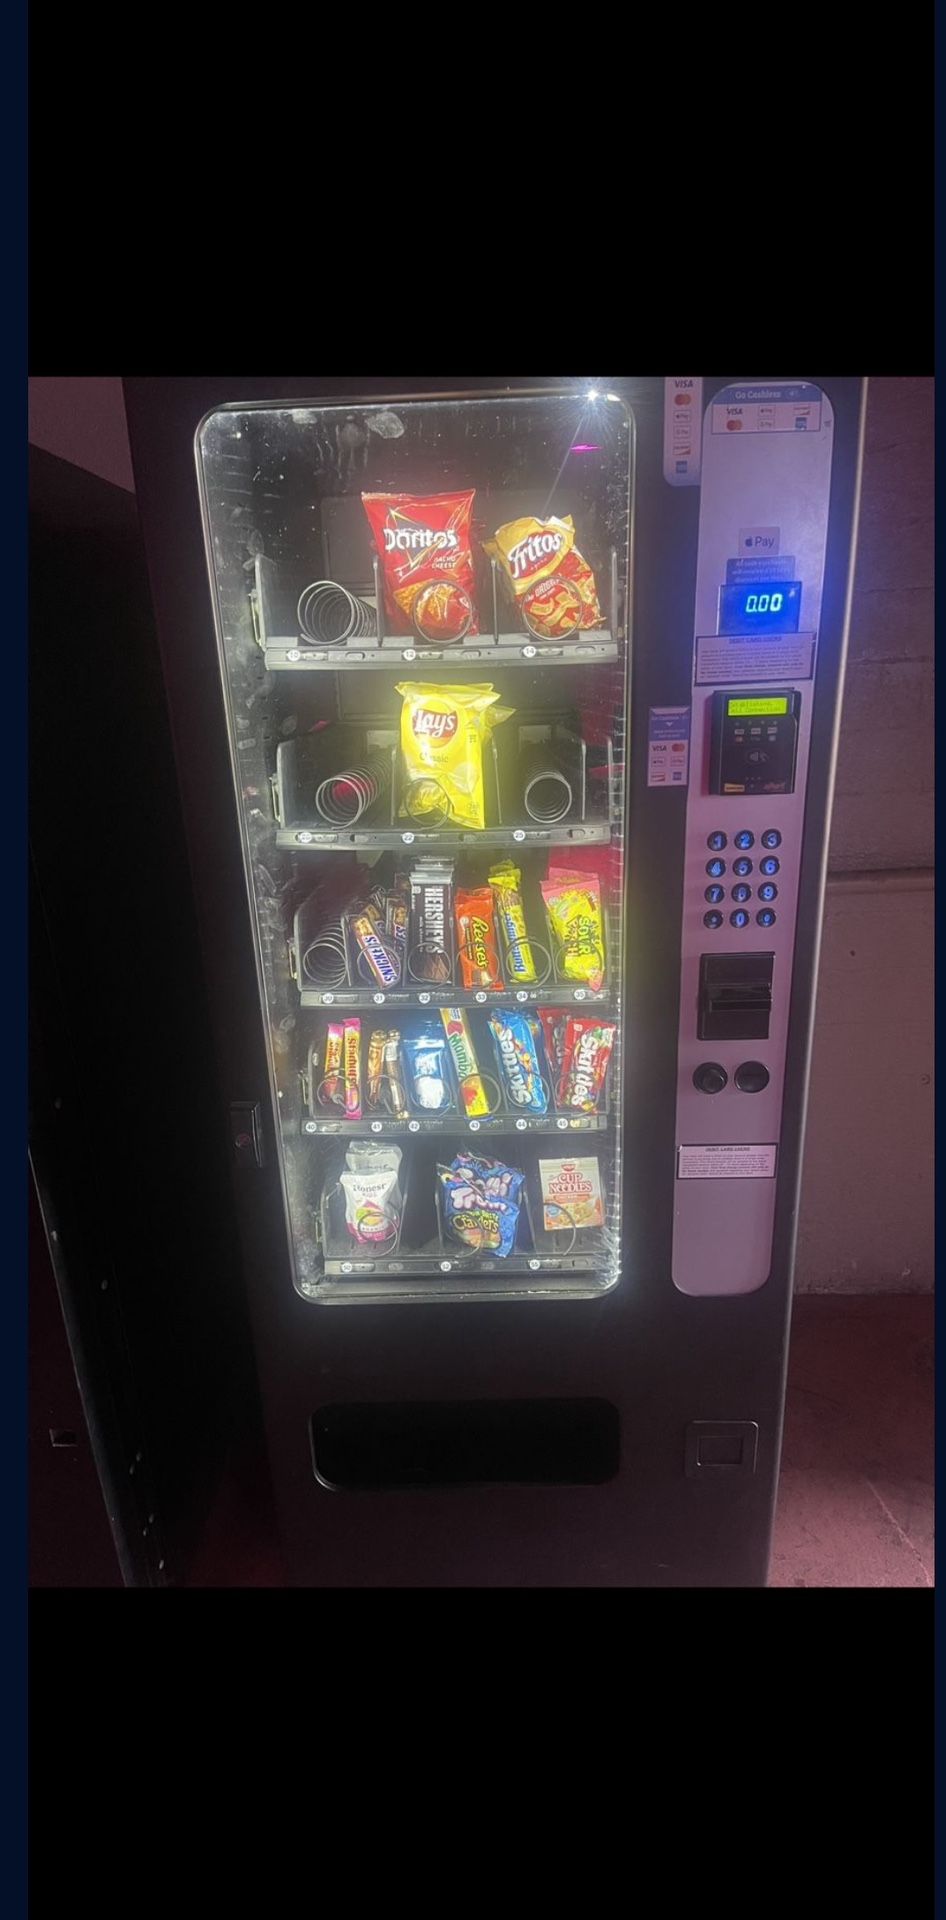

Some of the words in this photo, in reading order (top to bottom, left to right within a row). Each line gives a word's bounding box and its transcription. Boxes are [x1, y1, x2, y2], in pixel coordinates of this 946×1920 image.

[674, 380, 694, 388] VISA
[726, 408, 743, 416] VISA
[383, 527, 458, 551] Doritos
[754, 536, 775, 548] Pay
[507, 532, 563, 578] Fritos
[745, 593, 784, 613] 0.00
[713, 835, 722, 848] 1
[740, 834, 750, 848] 2
[767, 833, 777, 847] 3
[711, 861, 721, 874] 4
[739, 861, 748, 874] 5
[765, 860, 775, 873] 6
[712, 888, 720, 900] 7
[763, 886, 774, 899] 9
[424, 886, 444, 953] HERSHEY'S
[735, 912, 745, 925] 0
[571, 1034, 598, 1105] Skittles
[559, 1173, 583, 1183] CUP
[549, 1181, 592, 1194] NOODLES
